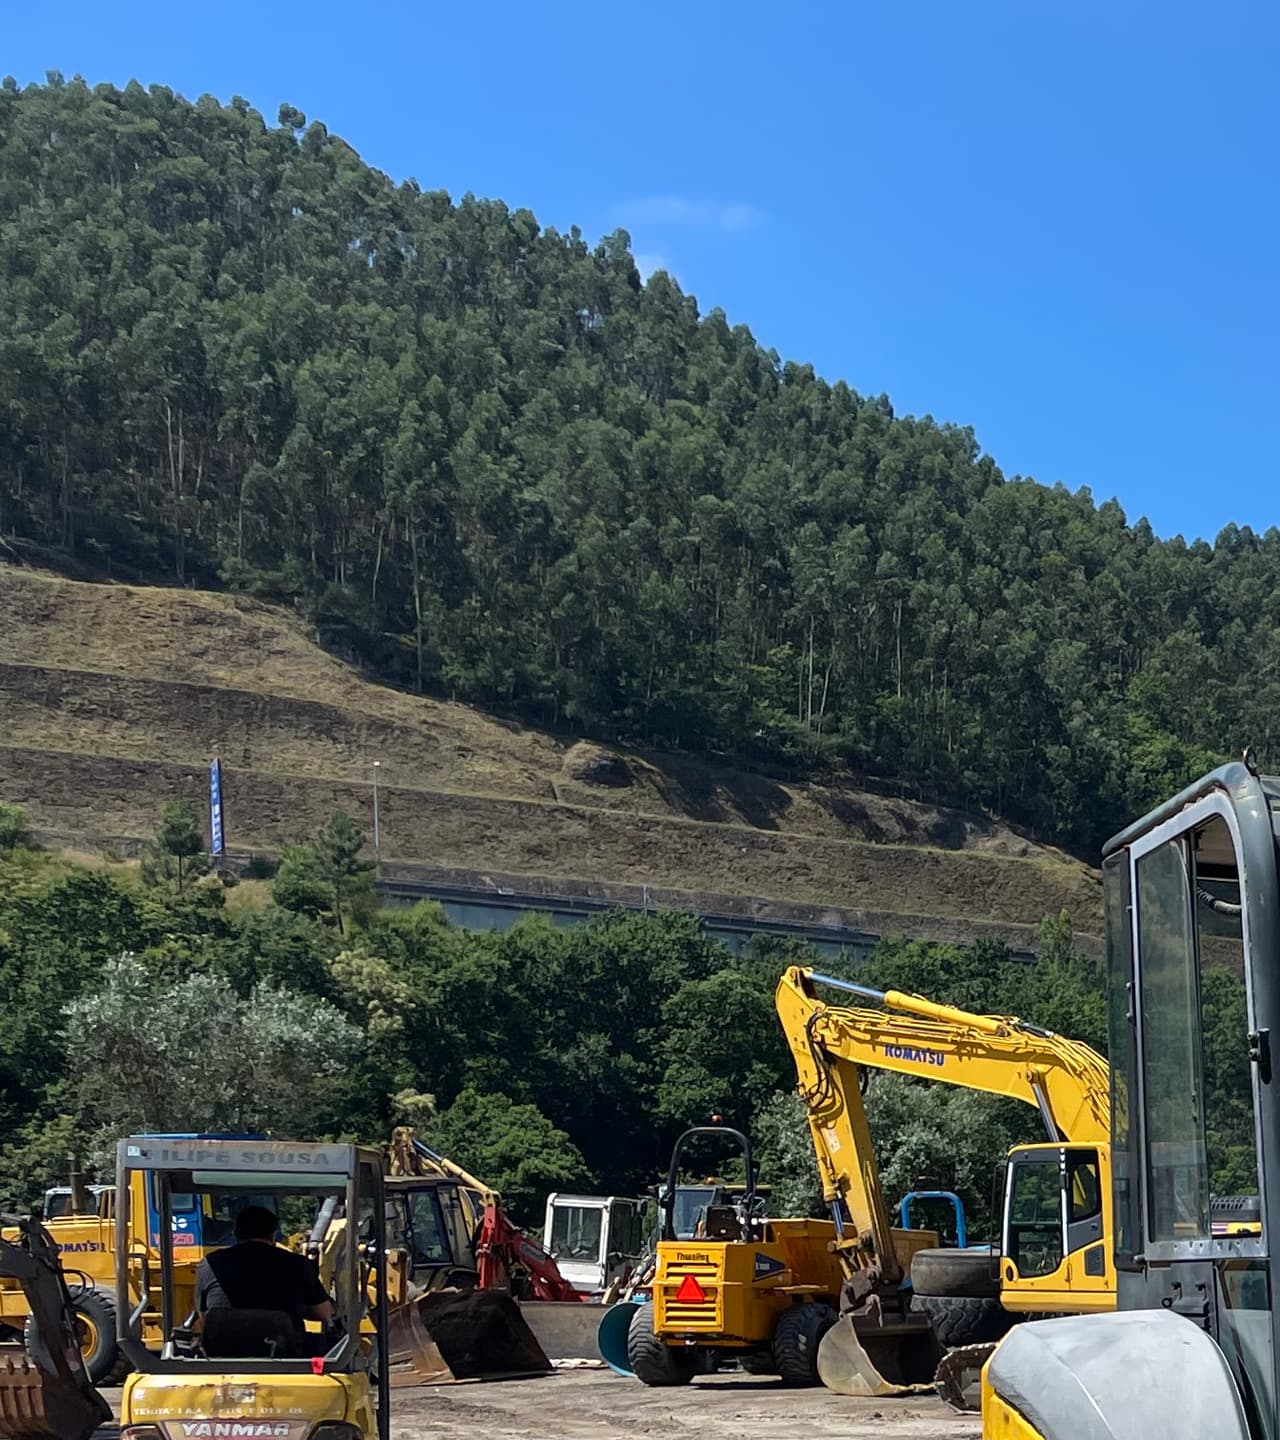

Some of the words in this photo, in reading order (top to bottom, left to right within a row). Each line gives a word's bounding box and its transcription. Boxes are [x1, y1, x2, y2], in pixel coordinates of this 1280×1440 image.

[884, 1043, 945, 1066] KOMATSU
[241, 1152, 329, 1165] SOUSA
[56, 1240, 107, 1253] OMATSU
[181, 1422, 290, 1438] YANMAR
